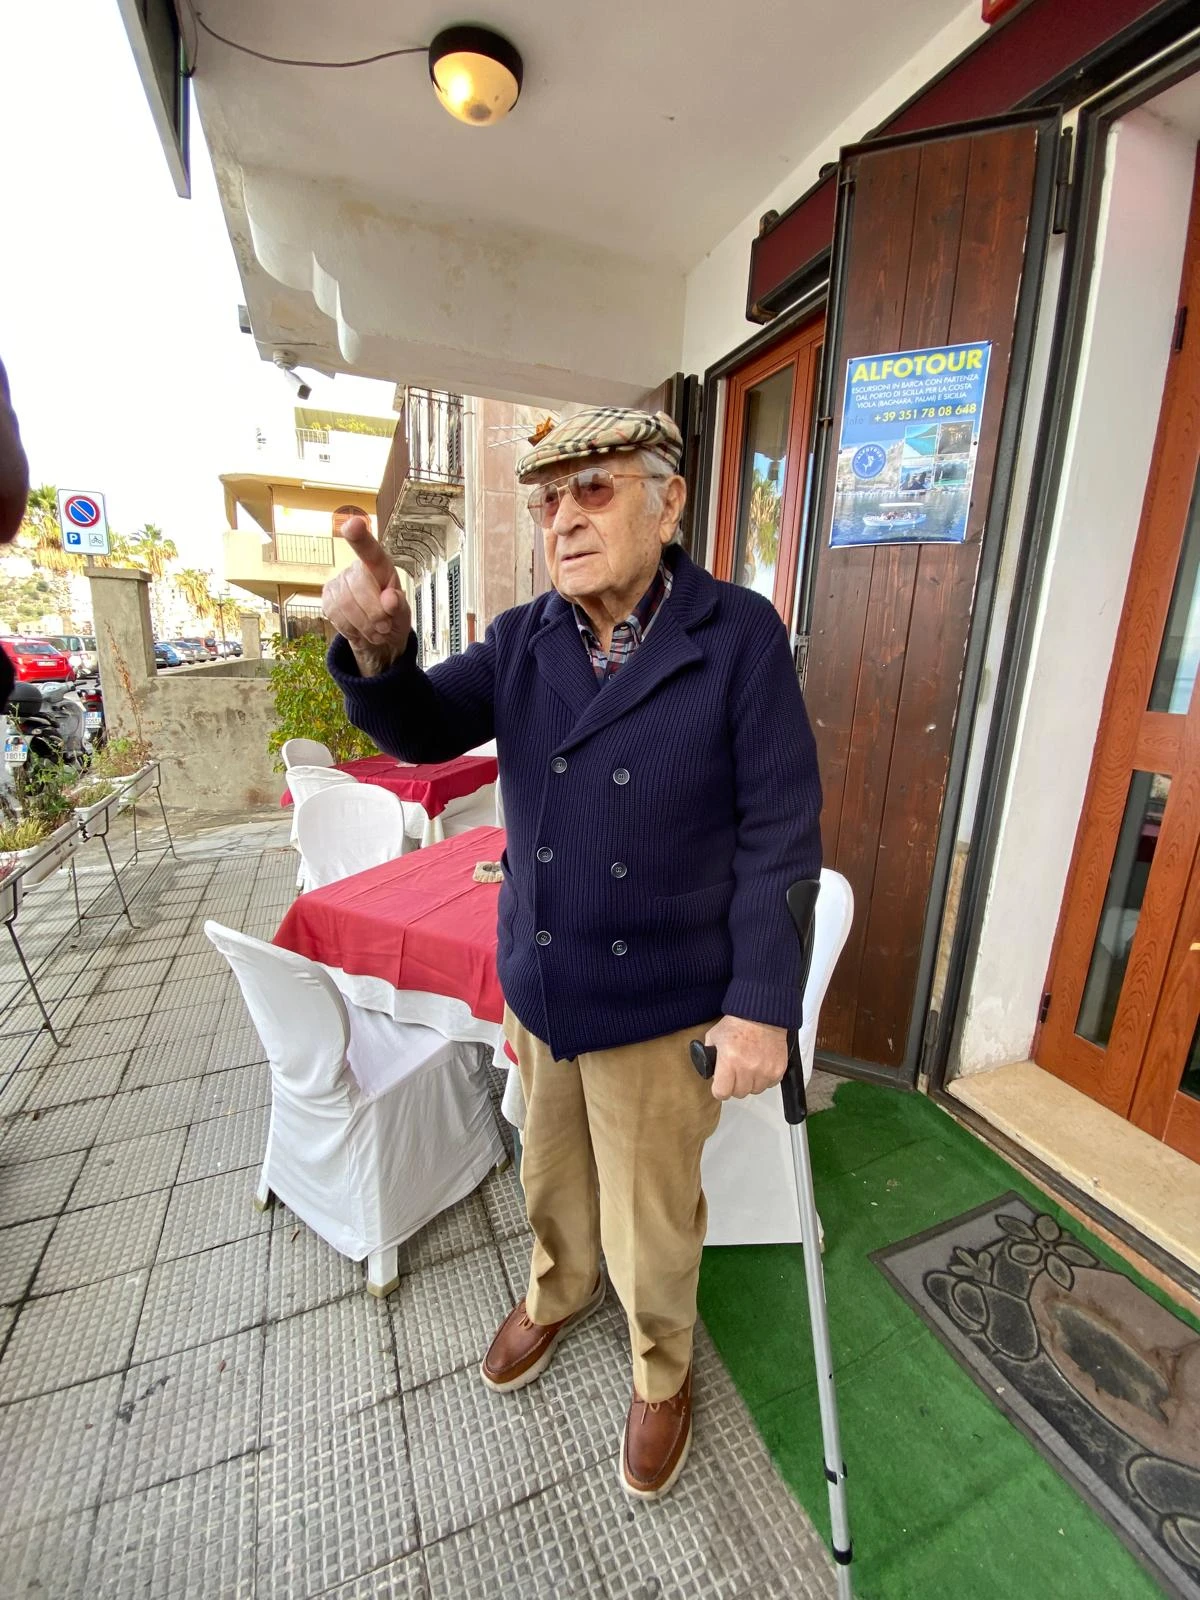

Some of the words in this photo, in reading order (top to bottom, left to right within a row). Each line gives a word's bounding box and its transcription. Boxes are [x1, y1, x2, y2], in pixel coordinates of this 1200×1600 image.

[852, 349, 983, 383] ALFOTOUR
[852, 384, 891, 394] ESCURSIONI
[892, 382, 900, 390] IN
[901, 380, 923, 389] BARCA
[925, 378, 942, 386] CON
[943, 374, 979, 383] PARTENZA
[856, 394, 868, 402] DAL
[869, 391, 892, 400] PORTO
[902, 388, 923, 397] SCILLA
[925, 386, 937, 394] PER
[938, 385, 947, 393] LA
[948, 382, 972, 391] COSTA
[943, 391, 967, 400] SICILIA
[874, 411, 896, 422] +39
[898, 408, 917, 420] 351
[921, 407, 935, 418] 78
[938, 405, 952, 416] 08
[955, 403, 977, 415] 648
[69, 533, 78, 543] P
